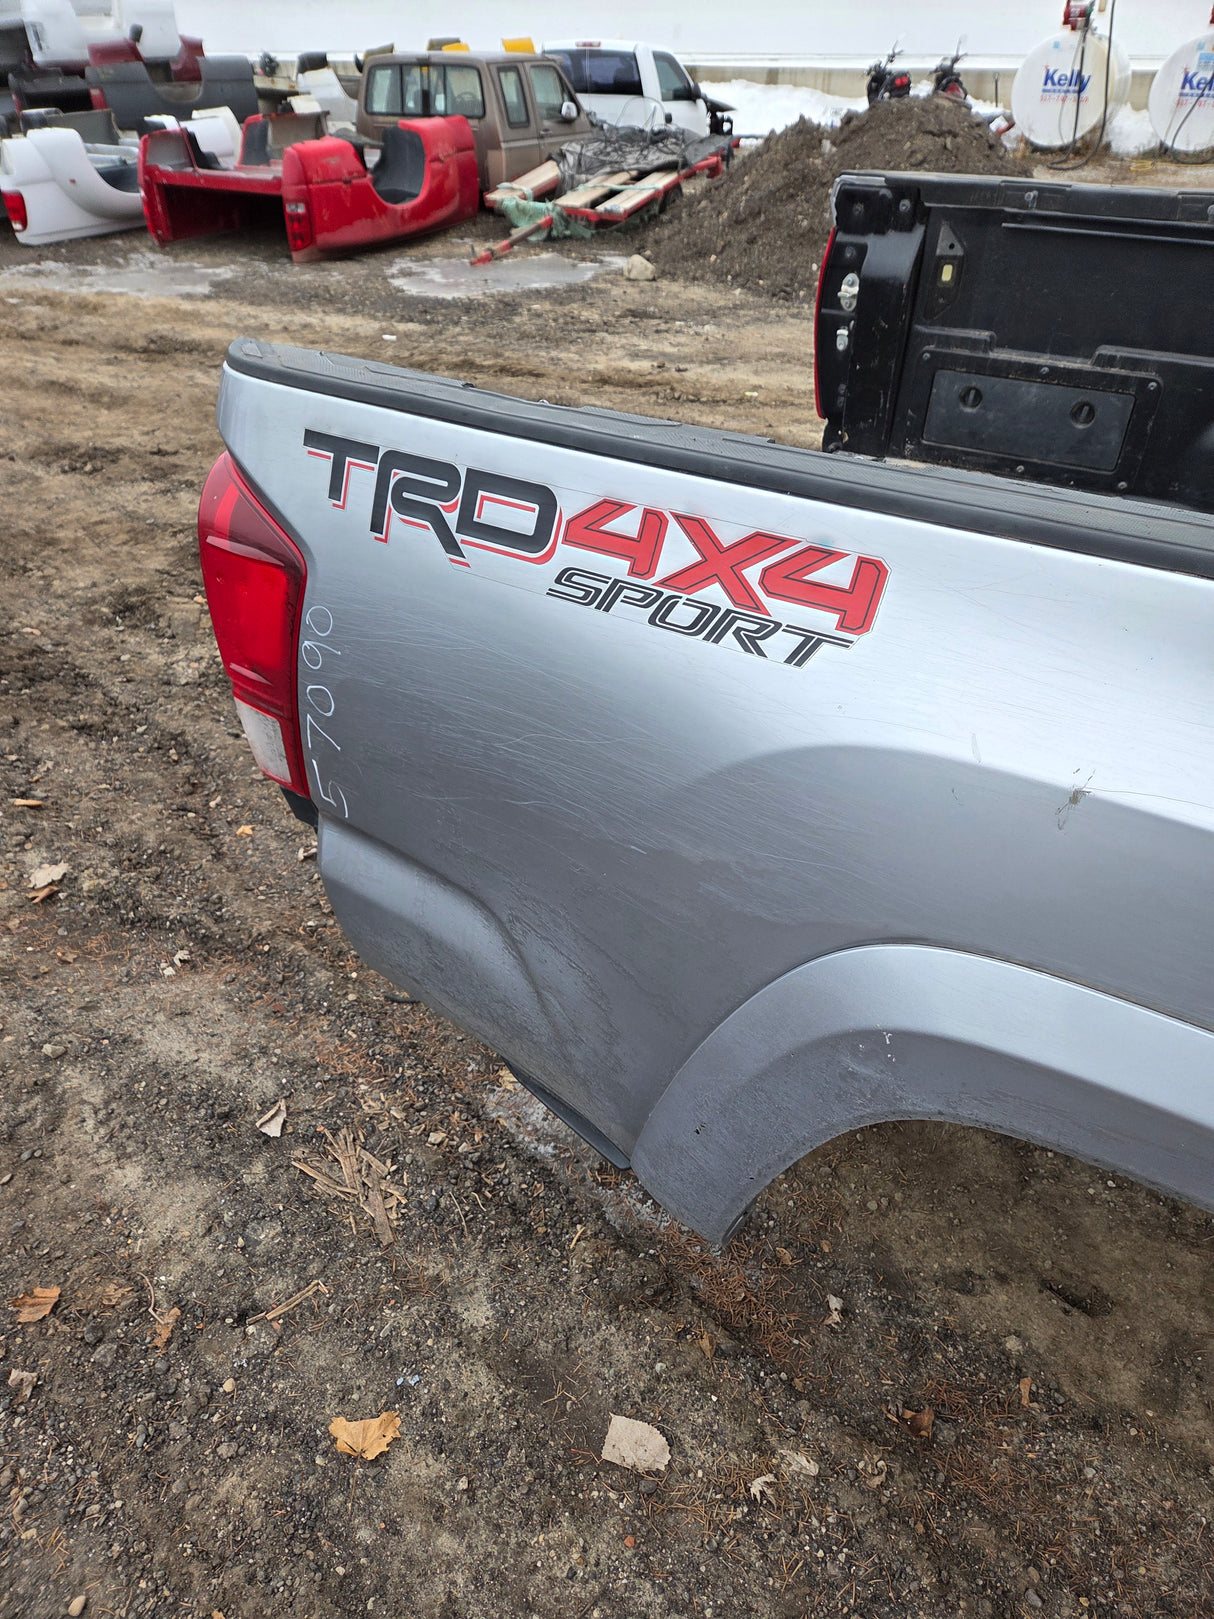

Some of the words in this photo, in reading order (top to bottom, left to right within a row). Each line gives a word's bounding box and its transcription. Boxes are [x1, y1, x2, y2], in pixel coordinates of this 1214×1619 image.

[1043, 68, 1091, 94] Kelly
[303, 429, 563, 567] TRD
[561, 498, 887, 635] 4X4
[546, 566, 855, 668] SPORT
[302, 606, 348, 817] 57090
